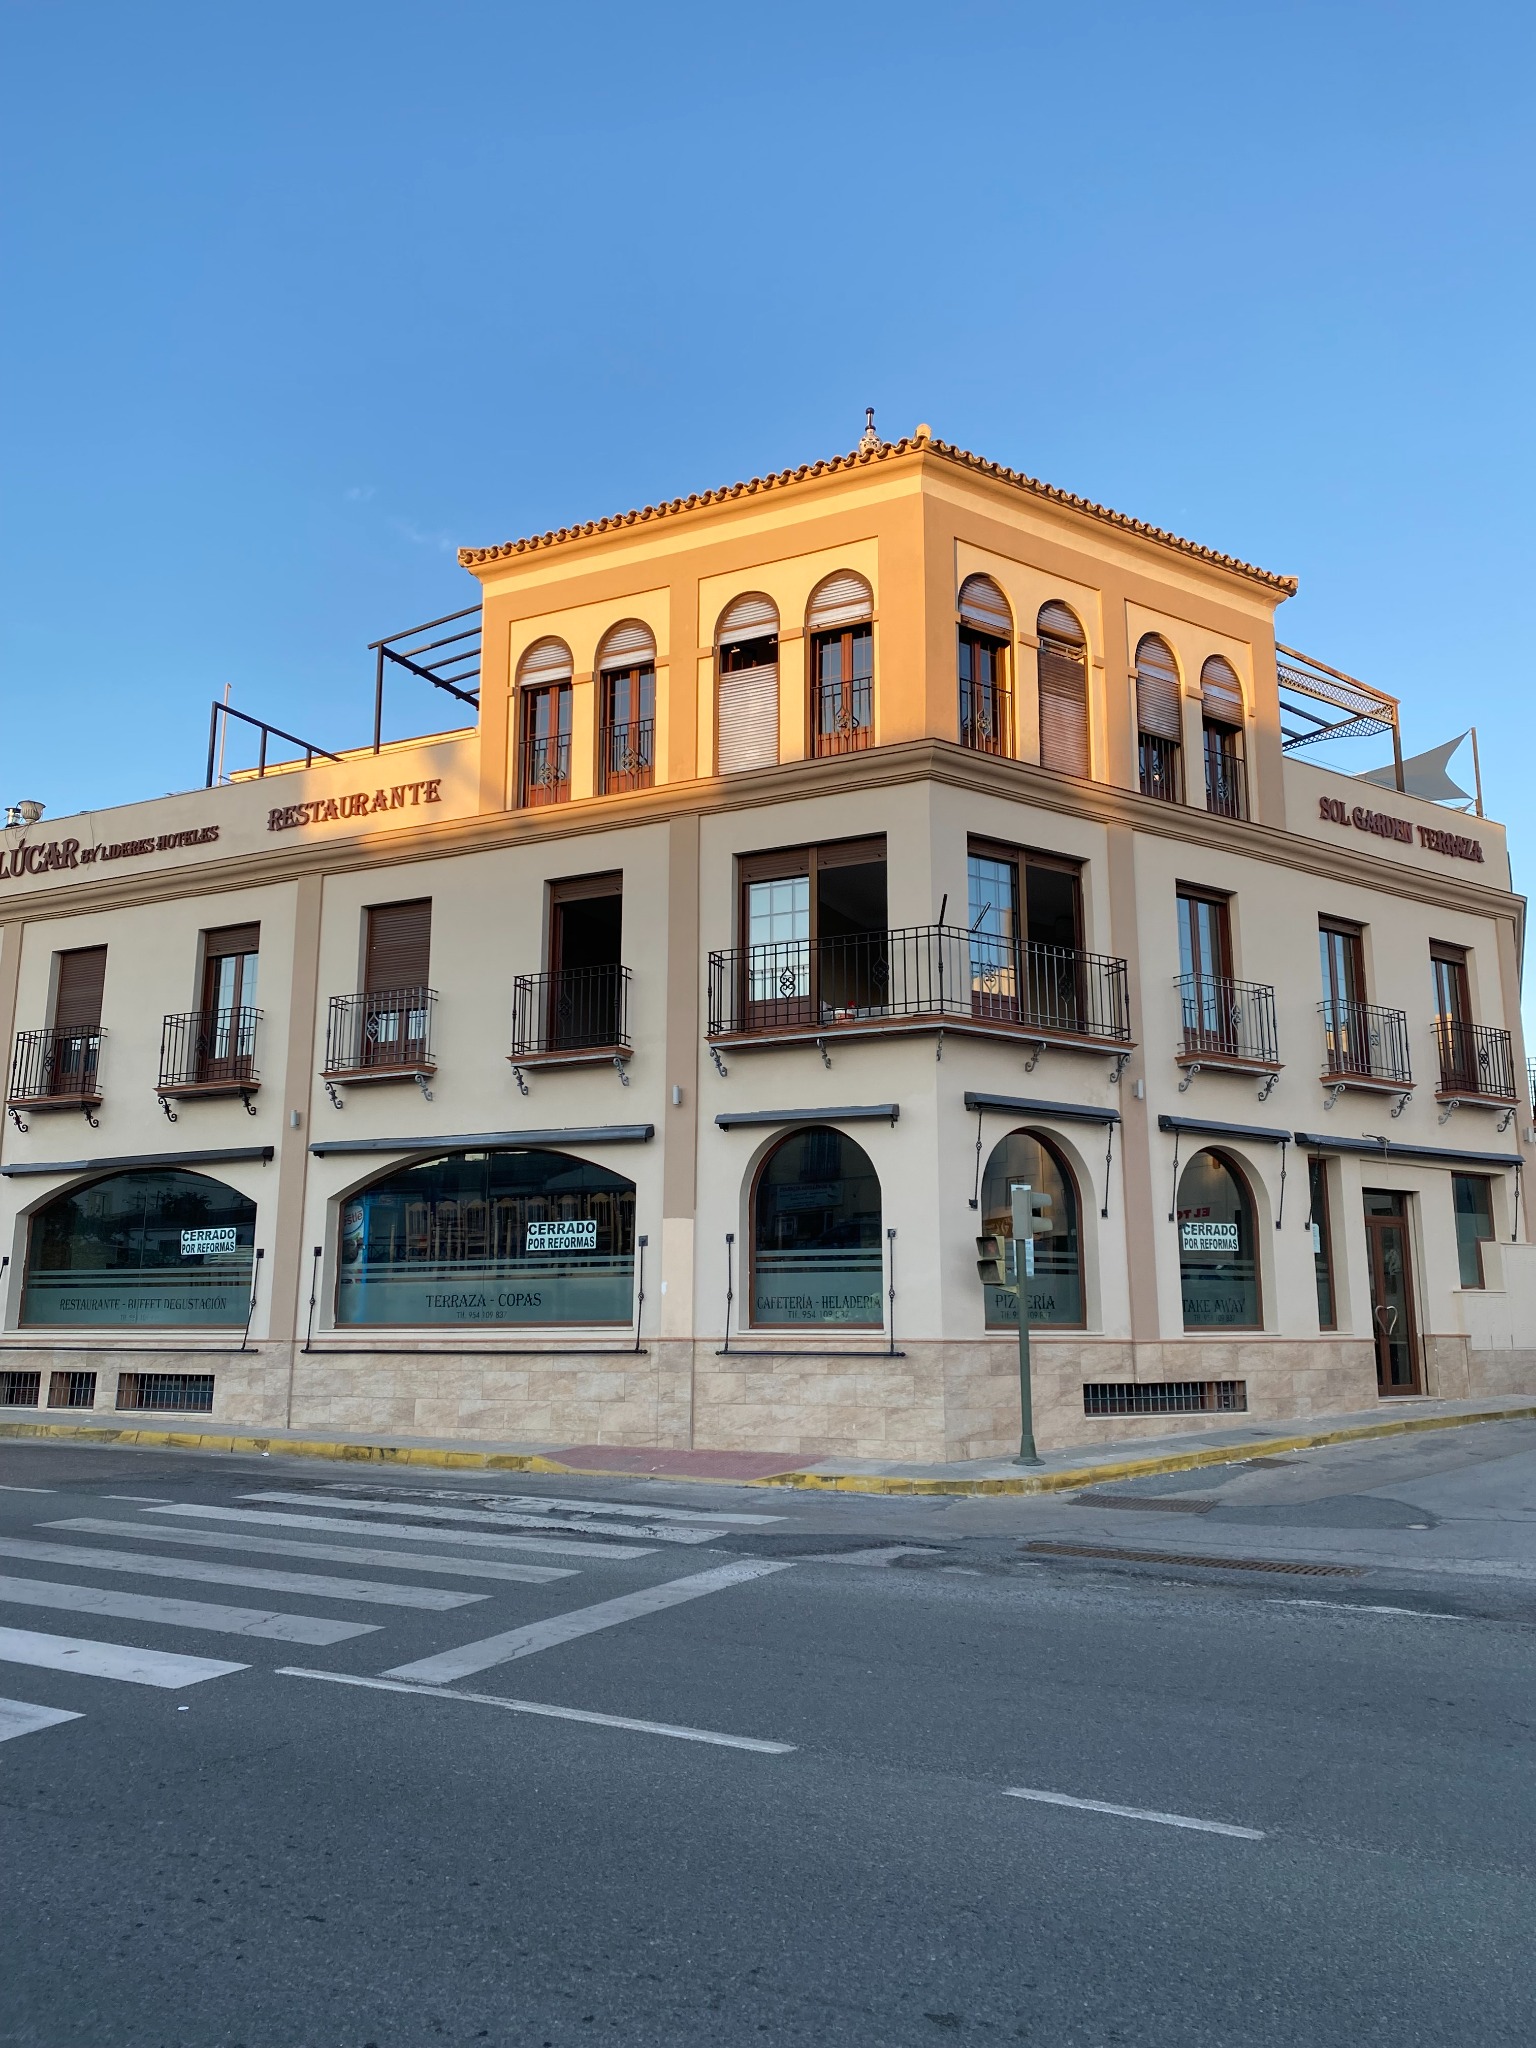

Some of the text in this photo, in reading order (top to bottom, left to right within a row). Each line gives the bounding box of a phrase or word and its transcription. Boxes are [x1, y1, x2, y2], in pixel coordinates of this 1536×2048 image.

[267, 778, 442, 831] RESTAURANTE
[1319, 796, 1485, 863] SOL GARDEN TERRAZA
[156, 825, 220, 850] HOTELES
[182, 1229, 235, 1241] CERRADO
[528, 1222, 596, 1236] CERRADO
[1183, 1224, 1237, 1236] CERRADO
[181, 1241, 235, 1253] POR REFORMAS
[528, 1236, 595, 1249] POR REFORMAS
[1184, 1238, 1238, 1250] POR REFORMAS
[59, 1298, 121, 1310] RESTAURANTE
[128, 1298, 162, 1310] BUFFET
[164, 1296, 227, 1310] DEGUSTACIÓN
[426, 1294, 486, 1309] TERRAZA
[498, 1292, 542, 1307] COPAS
[757, 1293, 813, 1310] CAFETERÍA
[994, 1293, 1056, 1310] PIZERÍA
[1182, 1298, 1245, 1313] TAKE AWAY
[802, 1310, 816, 1319] 954
